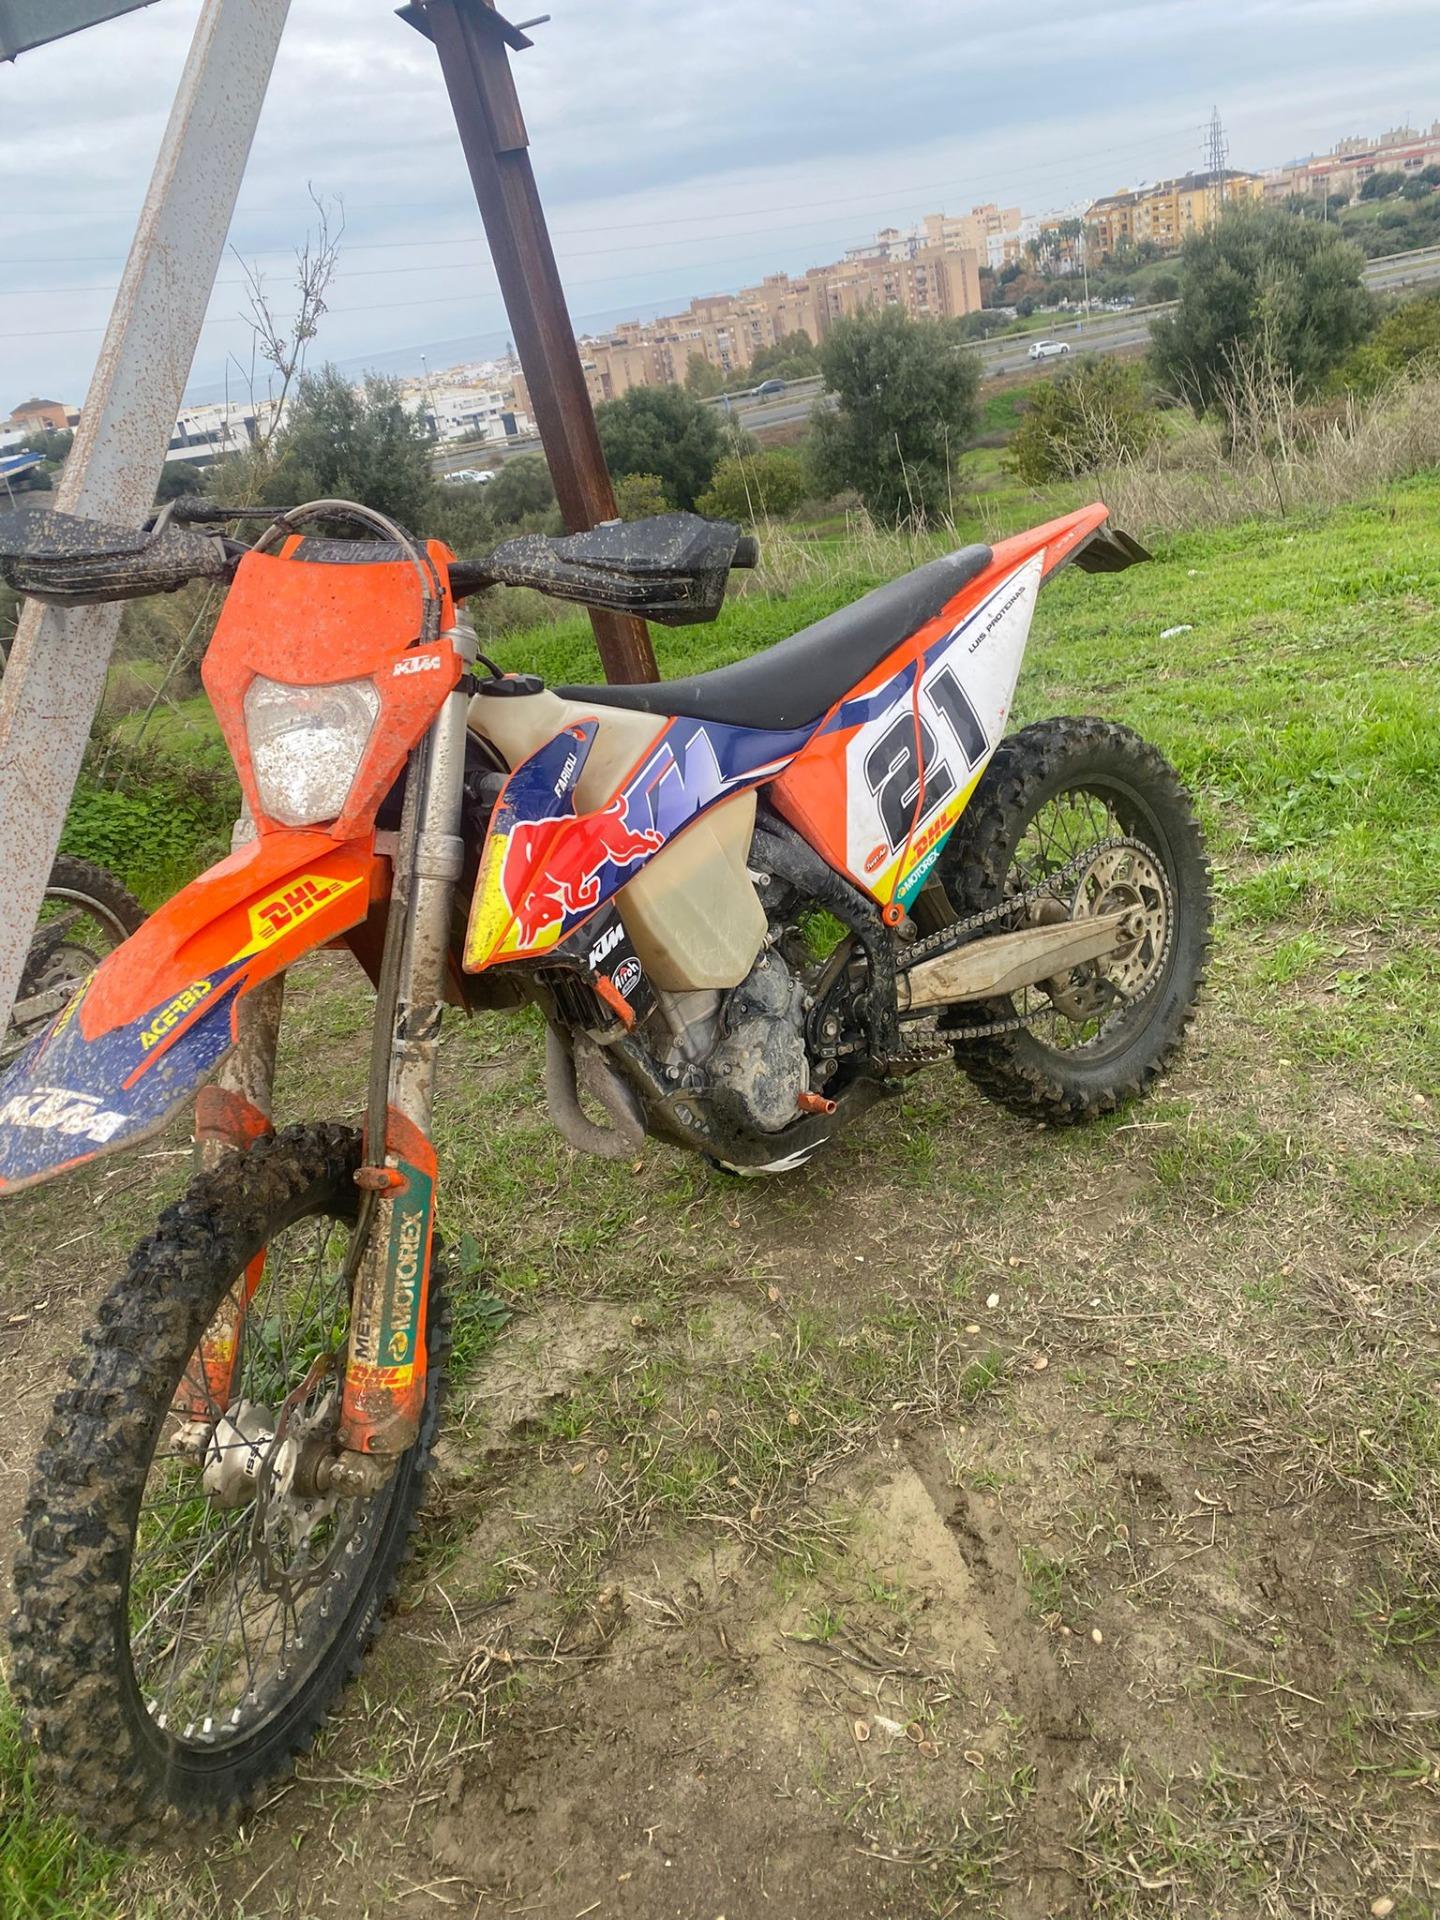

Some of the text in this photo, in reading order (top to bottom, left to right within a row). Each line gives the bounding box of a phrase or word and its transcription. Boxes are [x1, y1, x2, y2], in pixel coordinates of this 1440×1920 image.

[392, 655, 441, 677] KTM
[968, 632, 987, 654] LUIS
[863, 664, 991, 856] 21
[914, 812, 954, 858] DHL
[904, 848, 940, 891] MOTOREX
[257, 880, 332, 931] DHL
[588, 922, 625, 971] KTM
[614, 962, 640, 989] Airoh
[140, 979, 212, 1050] ACERBIS
[0, 1086, 129, 1144] KTM
[390, 1209, 424, 1331] MOTOREX
[350, 1364, 408, 1388] DHL
